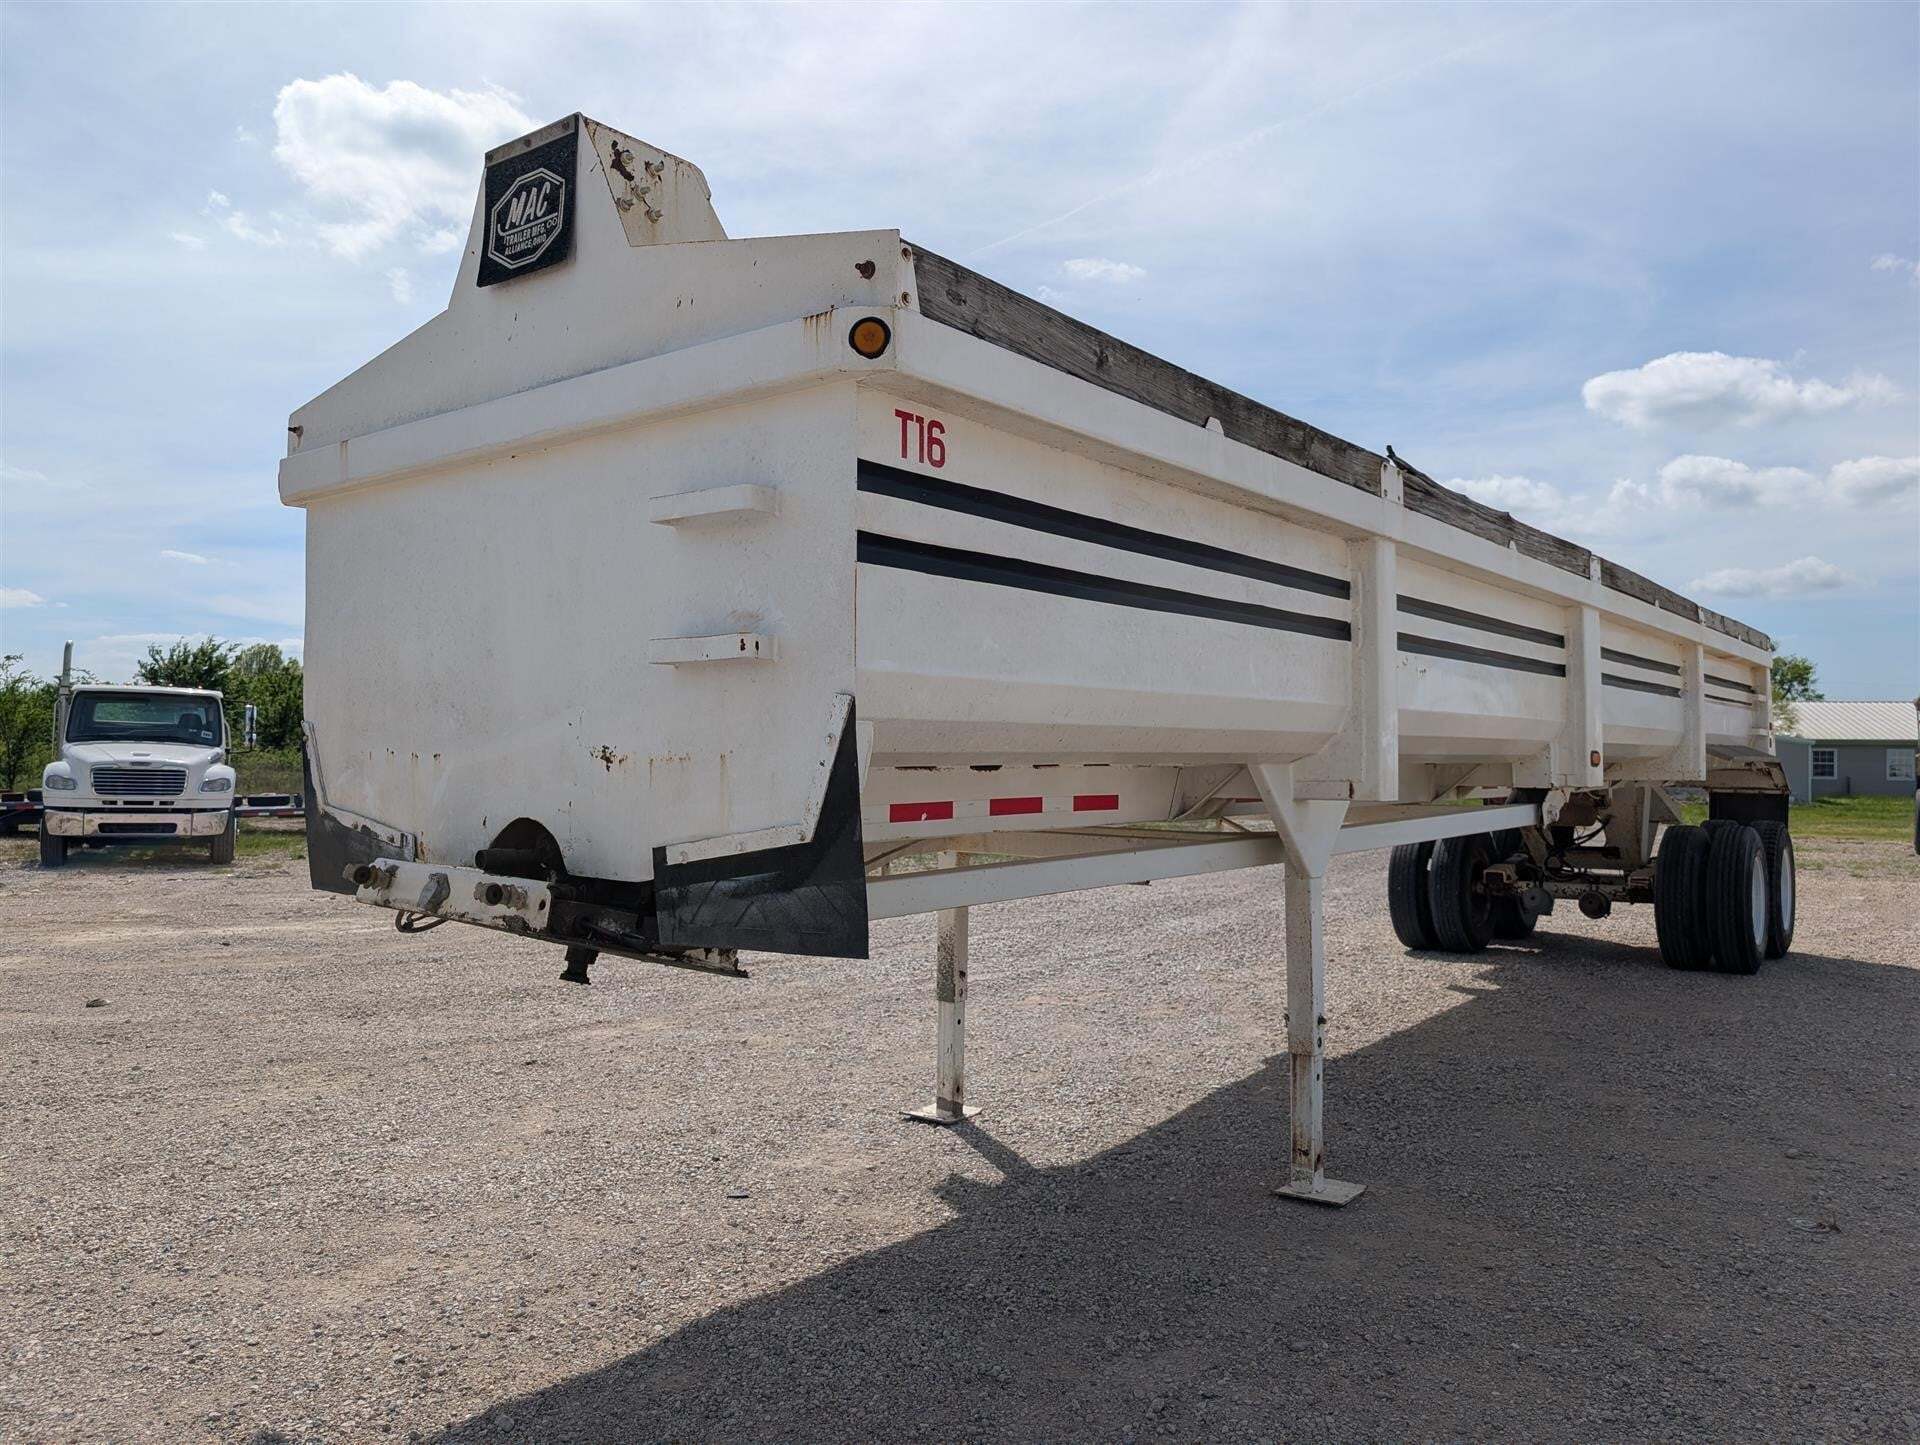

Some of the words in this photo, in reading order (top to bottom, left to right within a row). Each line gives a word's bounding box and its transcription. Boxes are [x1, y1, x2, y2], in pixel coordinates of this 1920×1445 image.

[505, 181, 551, 230] MAC
[506, 229, 531, 246] TRAILER
[895, 408, 946, 468] T16
